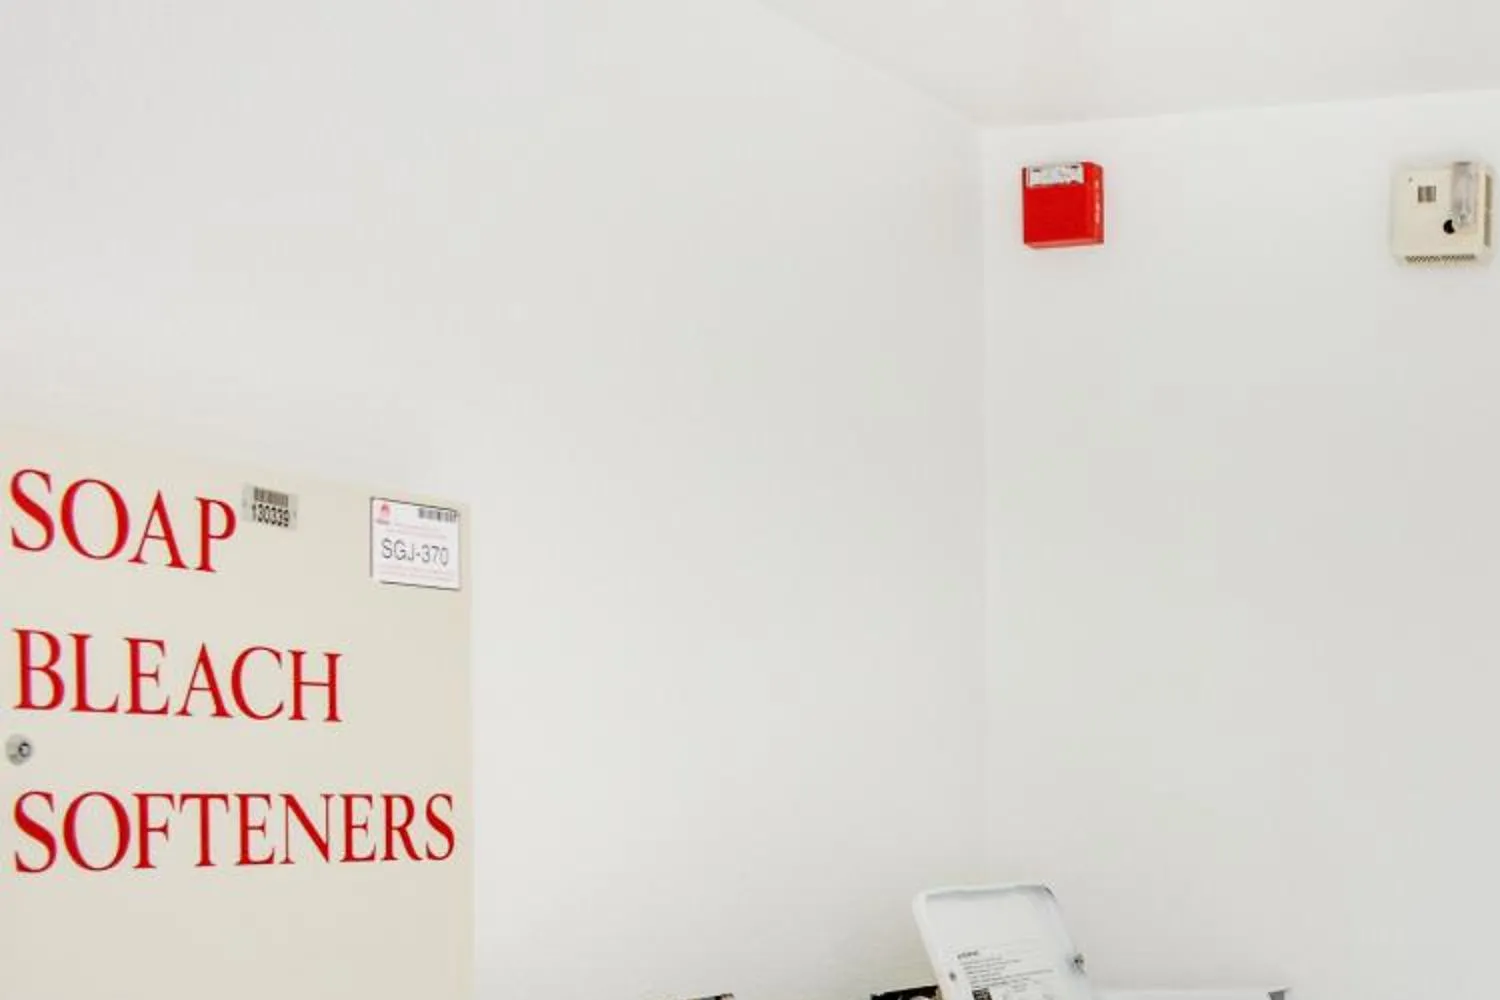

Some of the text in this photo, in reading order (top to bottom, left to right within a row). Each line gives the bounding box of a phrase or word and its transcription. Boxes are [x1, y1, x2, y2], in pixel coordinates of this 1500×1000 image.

[9, 469, 237, 573] SOAP
[252, 503, 289, 527] 130339
[382, 538, 449, 566] SGJ-370
[13, 628, 342, 723] BLEACH
[14, 790, 456, 873] SOFTENERS
